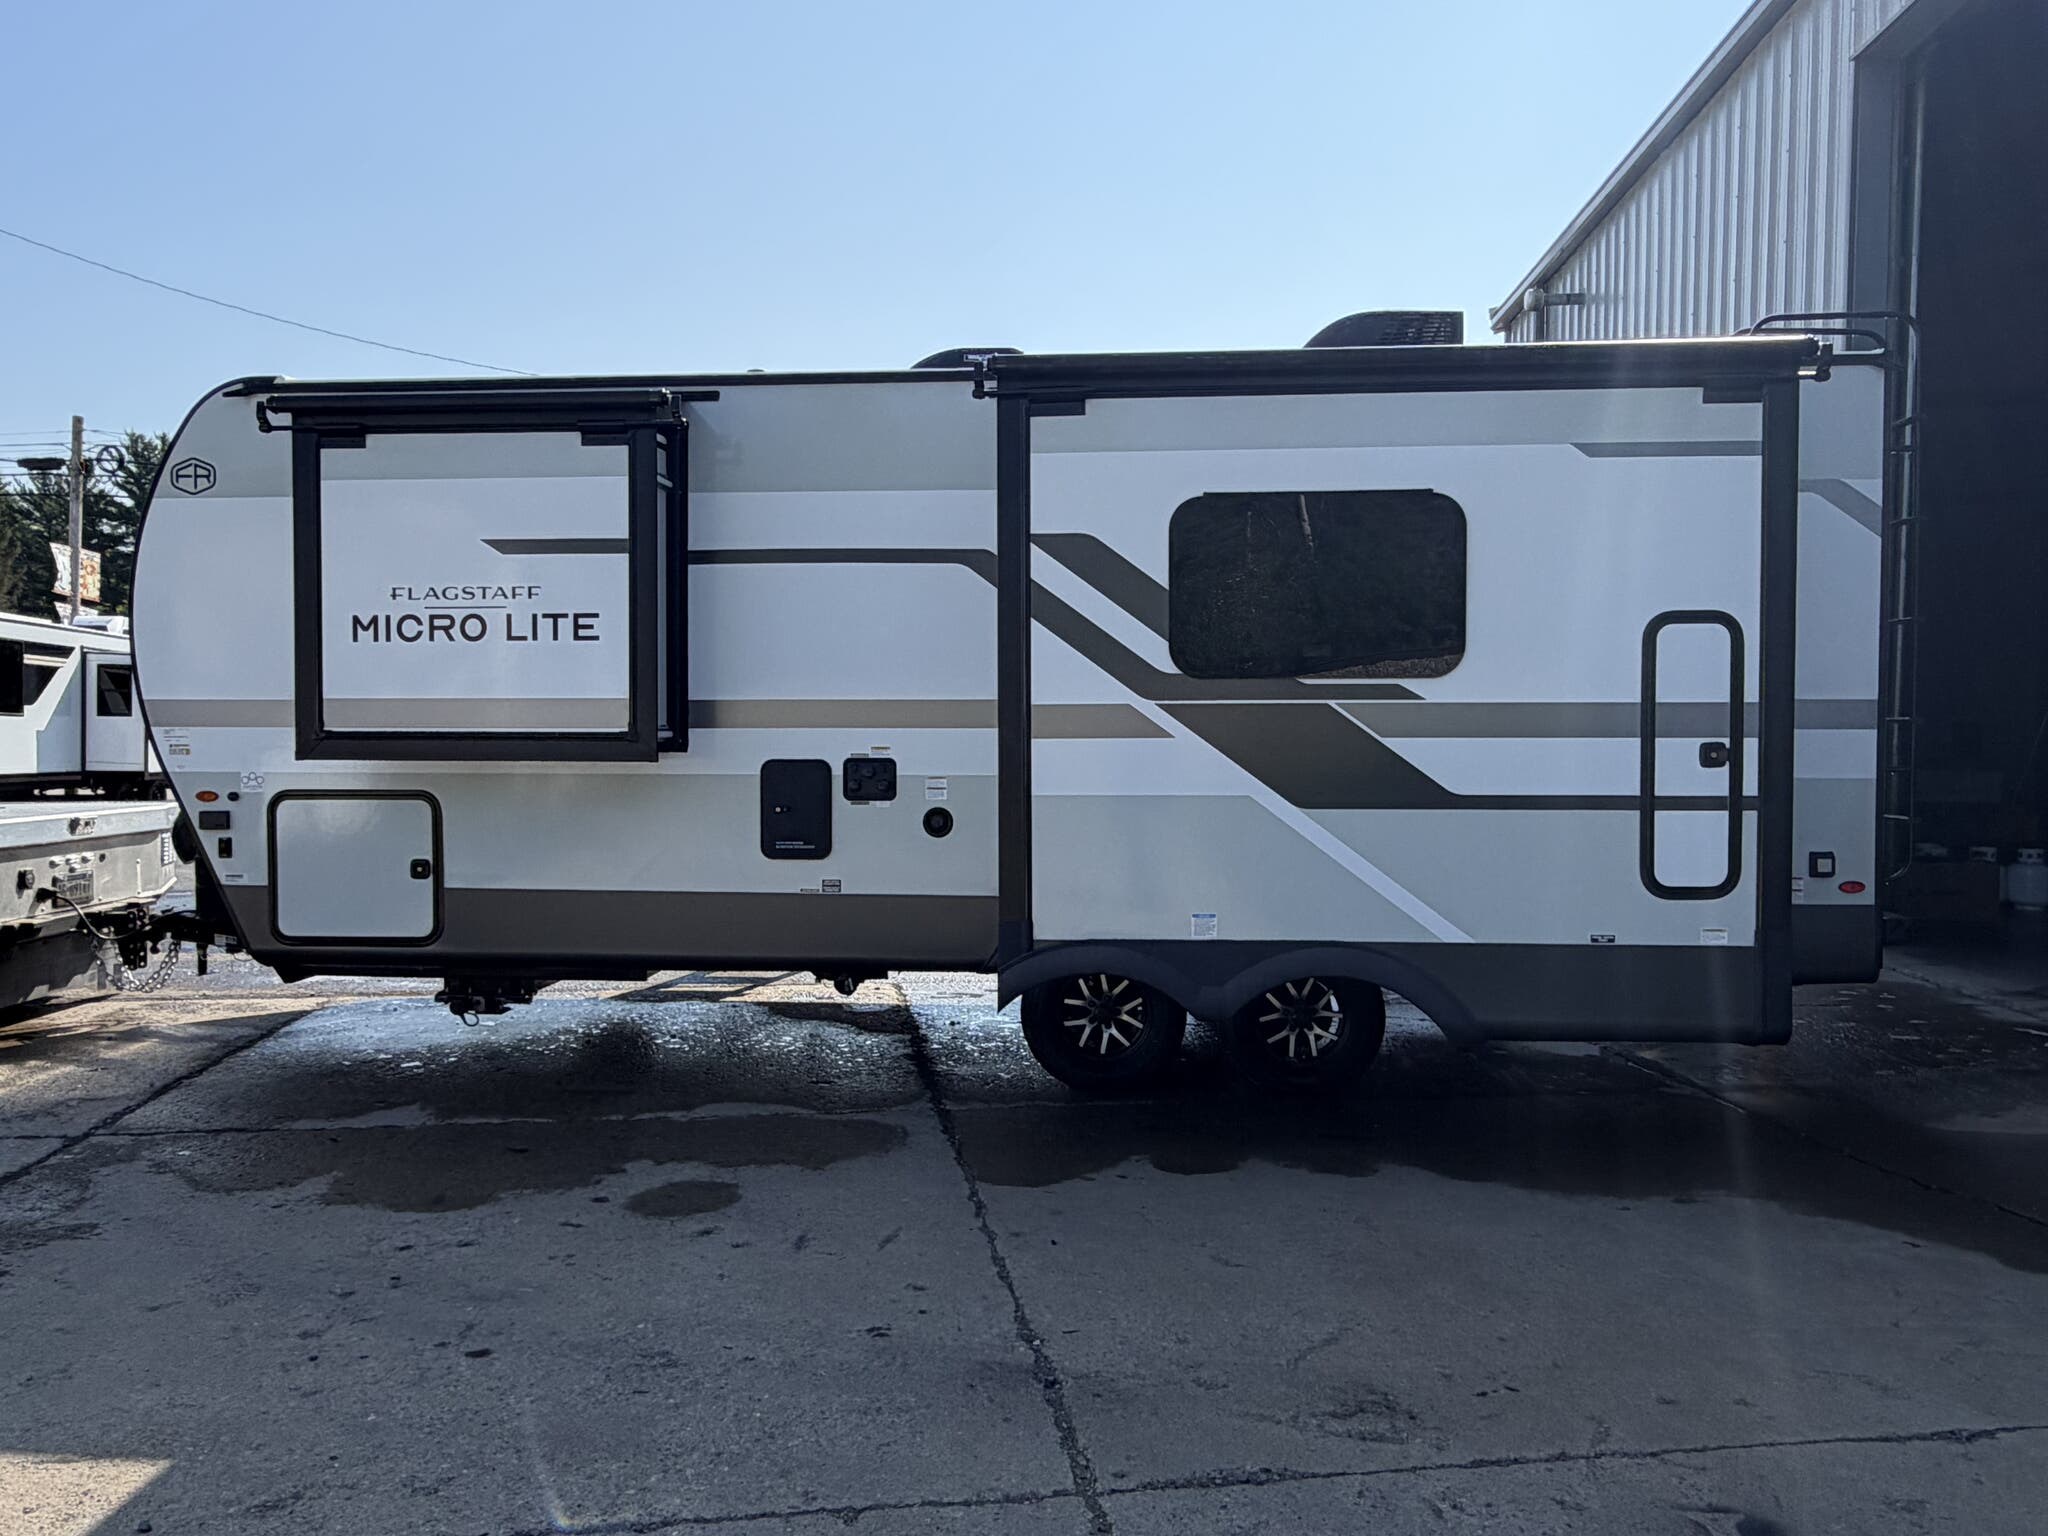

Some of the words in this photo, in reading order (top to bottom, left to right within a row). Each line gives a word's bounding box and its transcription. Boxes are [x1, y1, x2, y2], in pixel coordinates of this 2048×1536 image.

[175, 462, 212, 490] FR
[390, 586, 542, 601] FLAGSTAFF
[352, 613, 488, 642] MICRO
[506, 613, 600, 642] LITE
